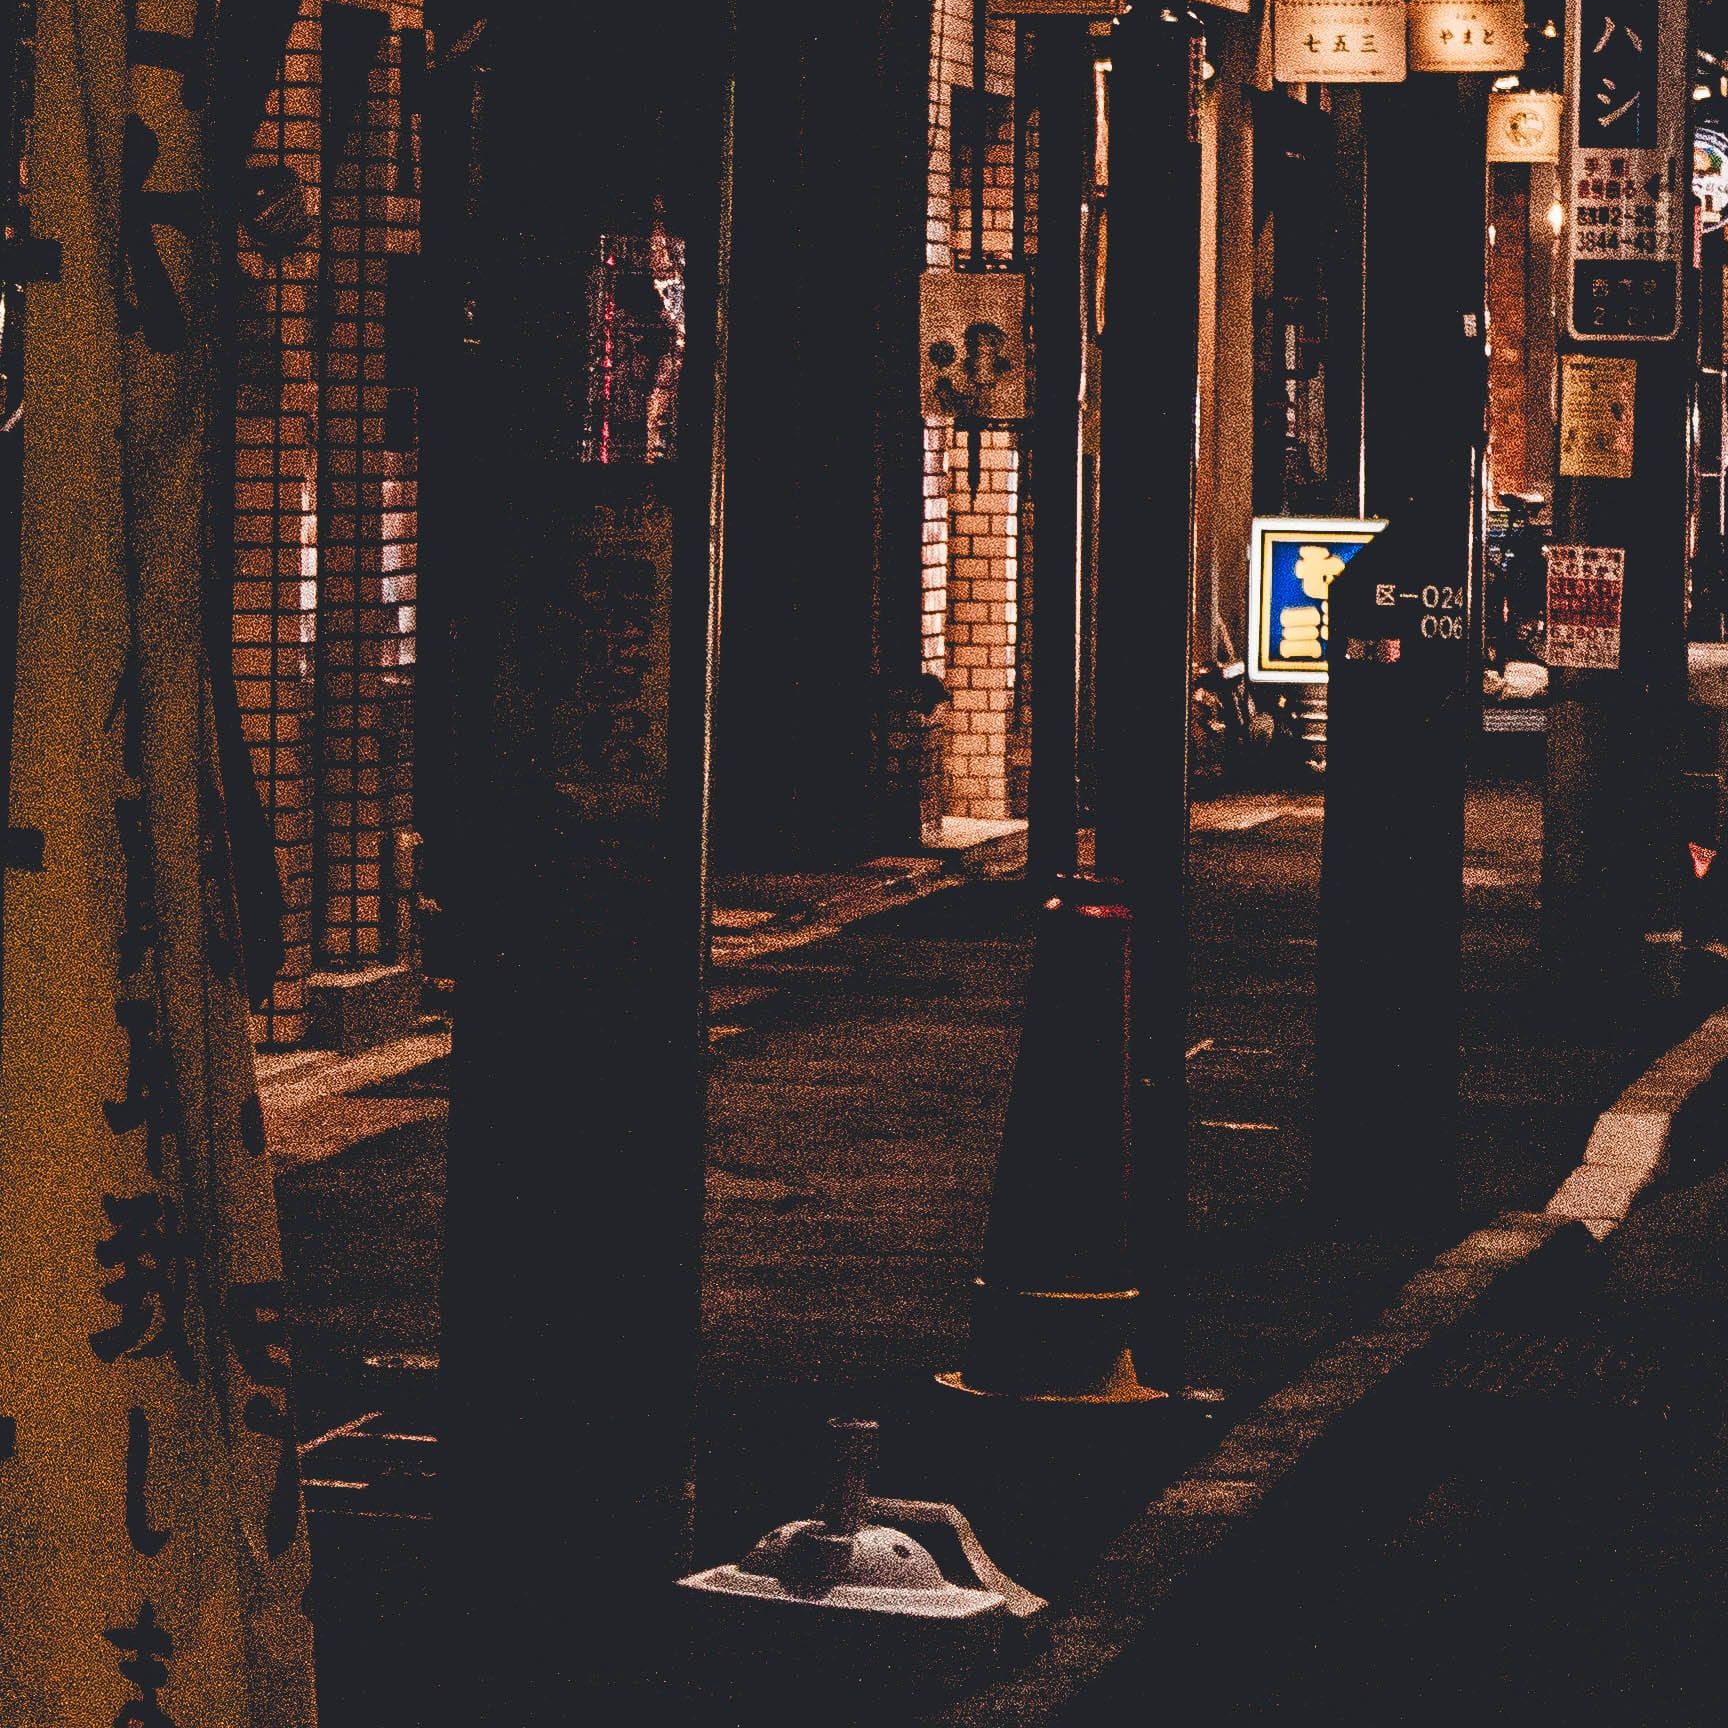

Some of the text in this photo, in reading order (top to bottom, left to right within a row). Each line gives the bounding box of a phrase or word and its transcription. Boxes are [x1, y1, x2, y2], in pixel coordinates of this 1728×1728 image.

[1303, 33, 1379, 54] 七五三
[1439, 28, 1495, 46] やまと
[1420, 613, 1464, 640] 006
